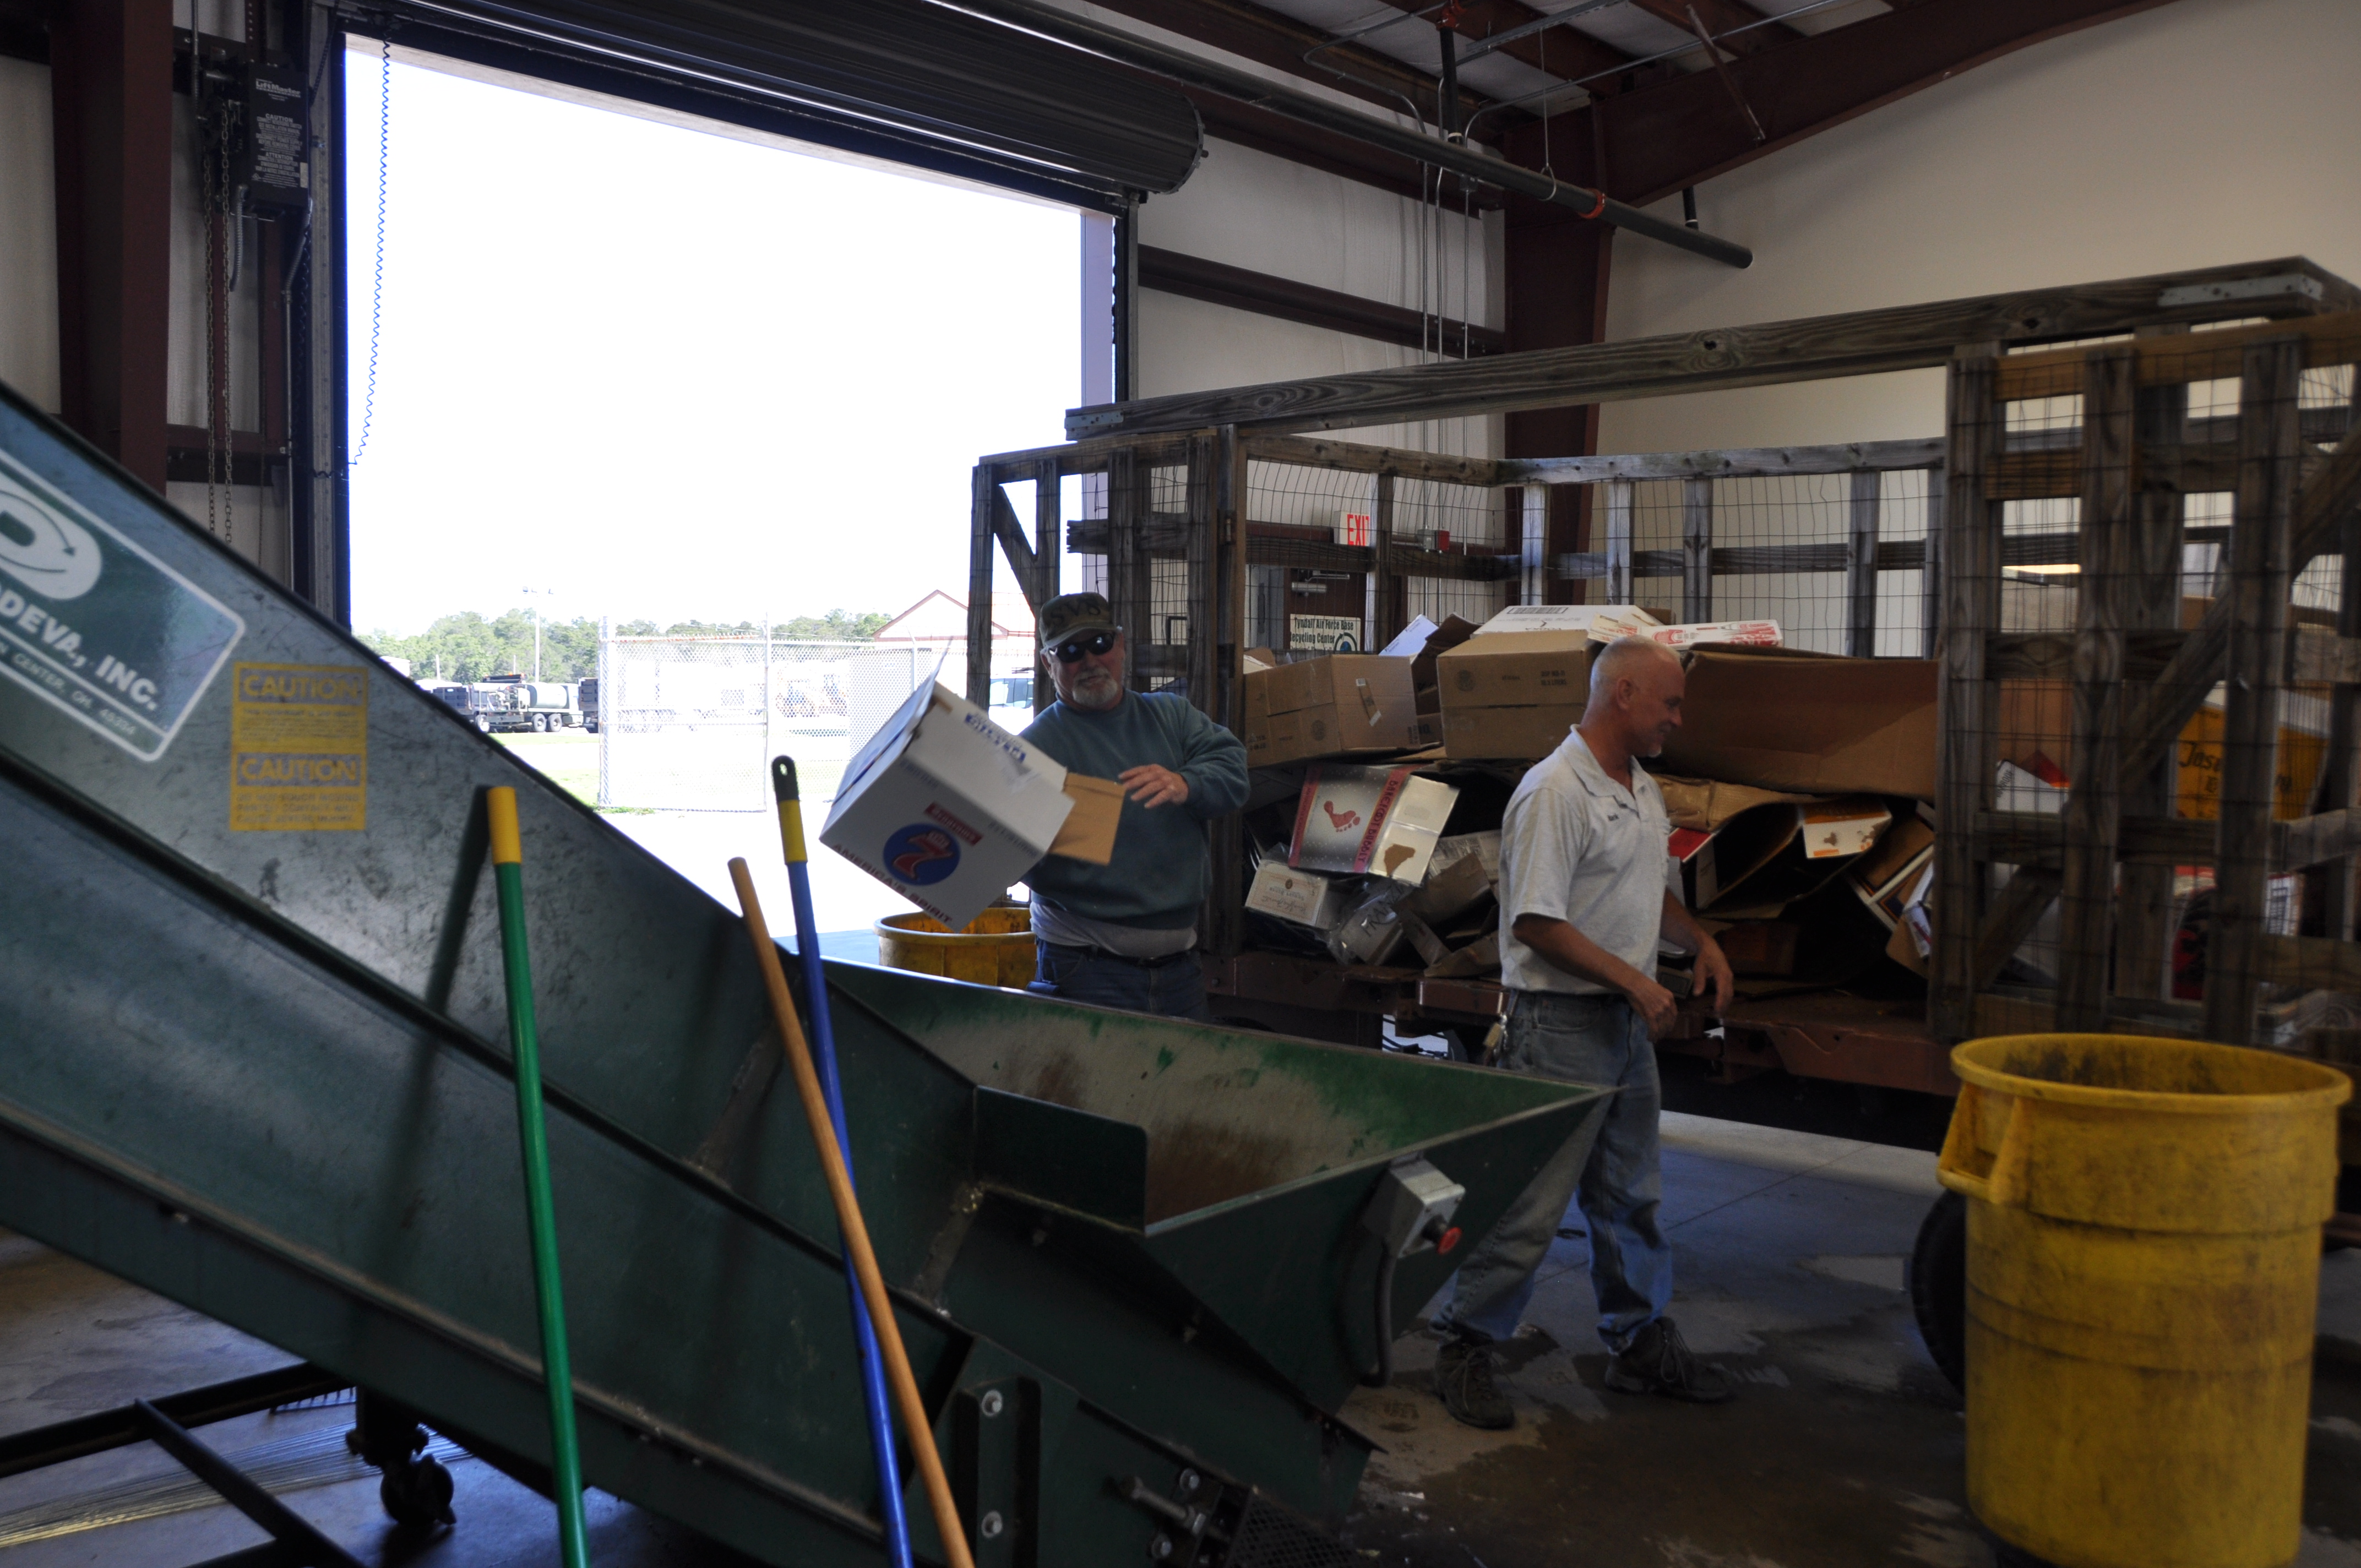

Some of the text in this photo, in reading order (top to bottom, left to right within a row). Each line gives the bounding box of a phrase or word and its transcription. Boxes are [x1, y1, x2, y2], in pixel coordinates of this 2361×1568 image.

[265, 113, 293, 123] CAUTION
[1294, 617, 1354, 631] Tyndall Air Force Base
[1290, 631, 1335, 644] ecycling Center
[0, 589, 158, 711] DEVA, INC.
[243, 674, 358, 699] CAUTION
[241, 758, 356, 782] CAUTION
[833, 844, 953, 923] AMERICA'S SPIRIT
